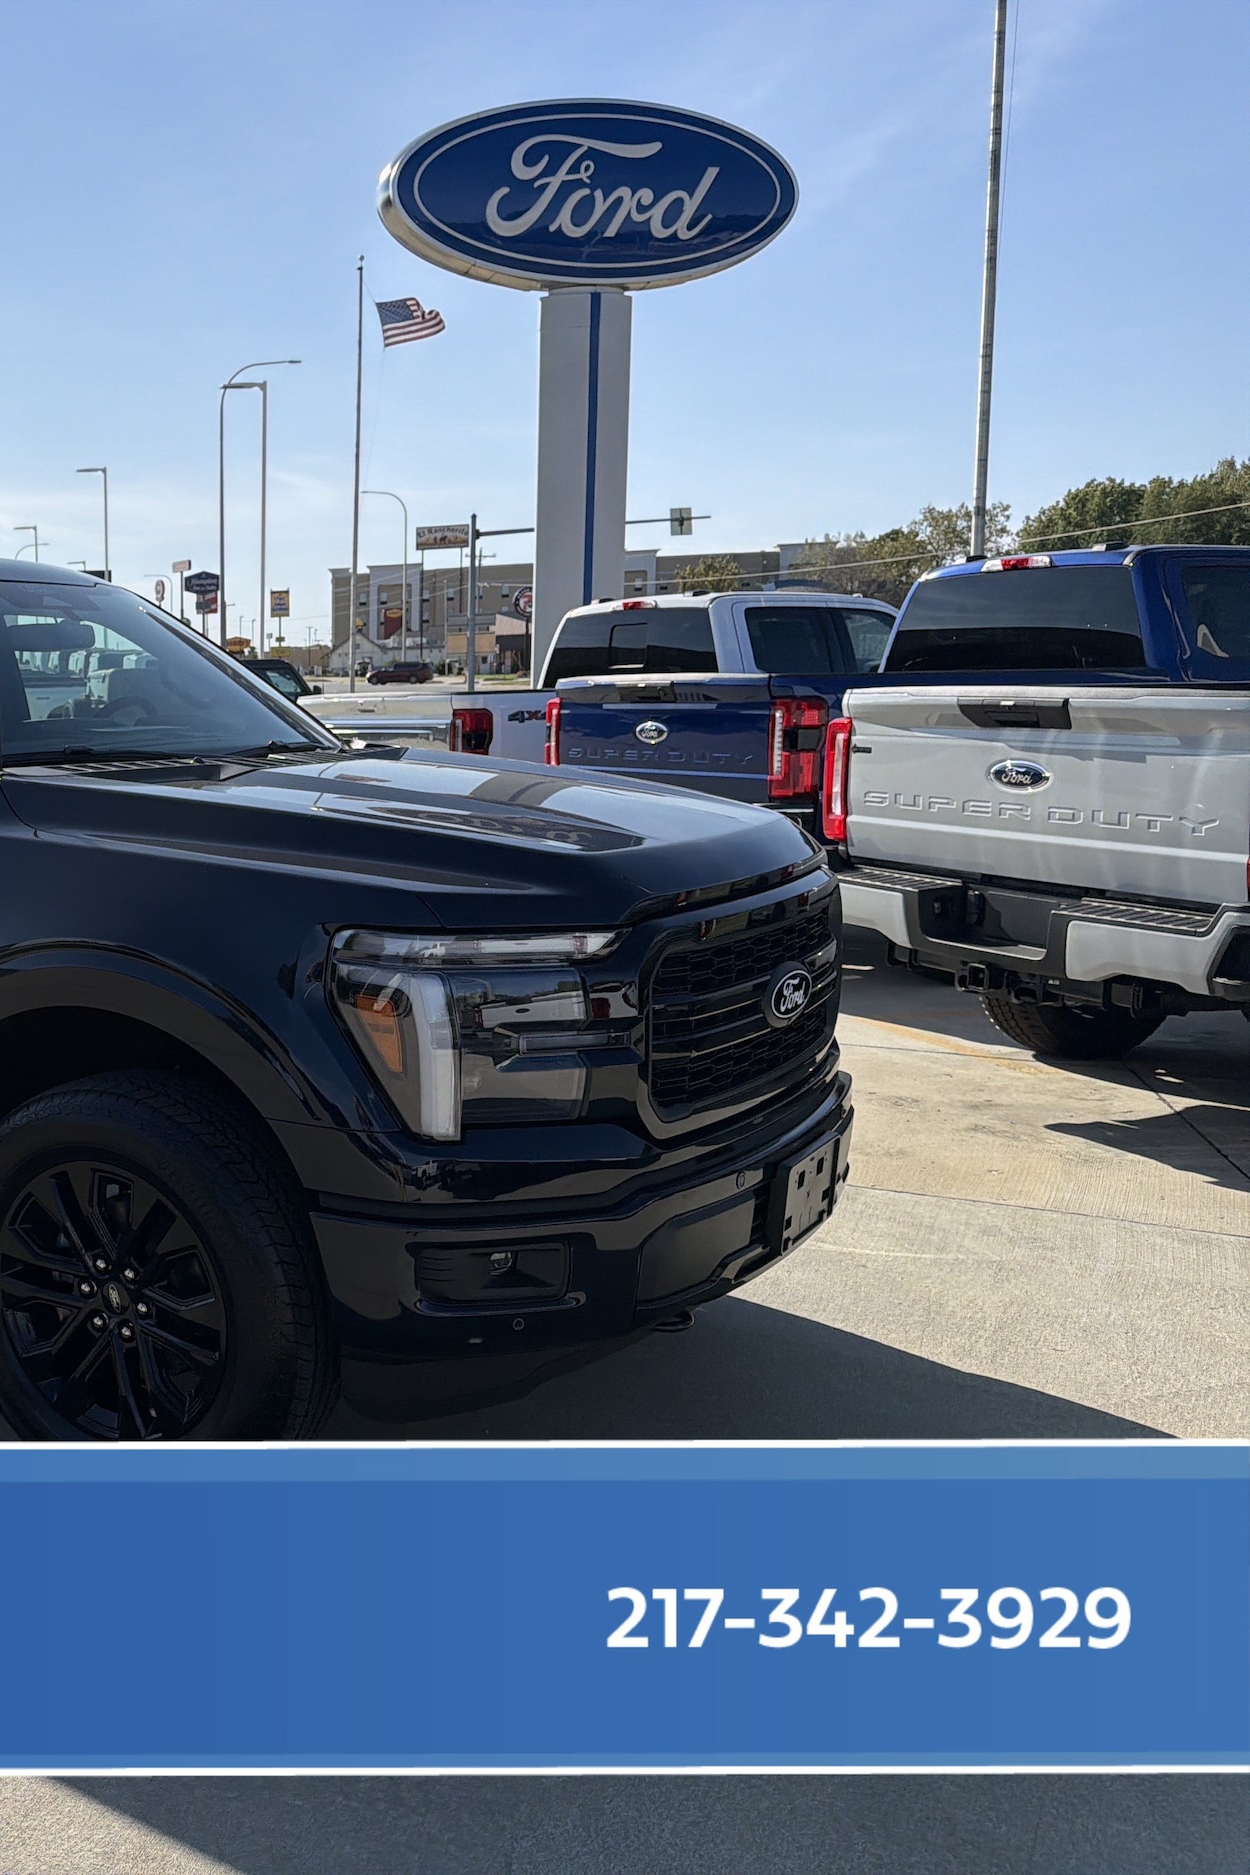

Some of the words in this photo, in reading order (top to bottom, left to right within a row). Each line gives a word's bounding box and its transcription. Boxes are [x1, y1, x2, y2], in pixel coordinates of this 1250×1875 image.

[486, 133, 721, 241] Ford
[568, 748, 659, 762] SUPER
[668, 751, 754, 765] DUTY
[1001, 766, 1034, 784] Ford
[863, 790, 1031, 820] SUPER
[1047, 805, 1220, 836] DUTY
[780, 977, 806, 1013] Ford
